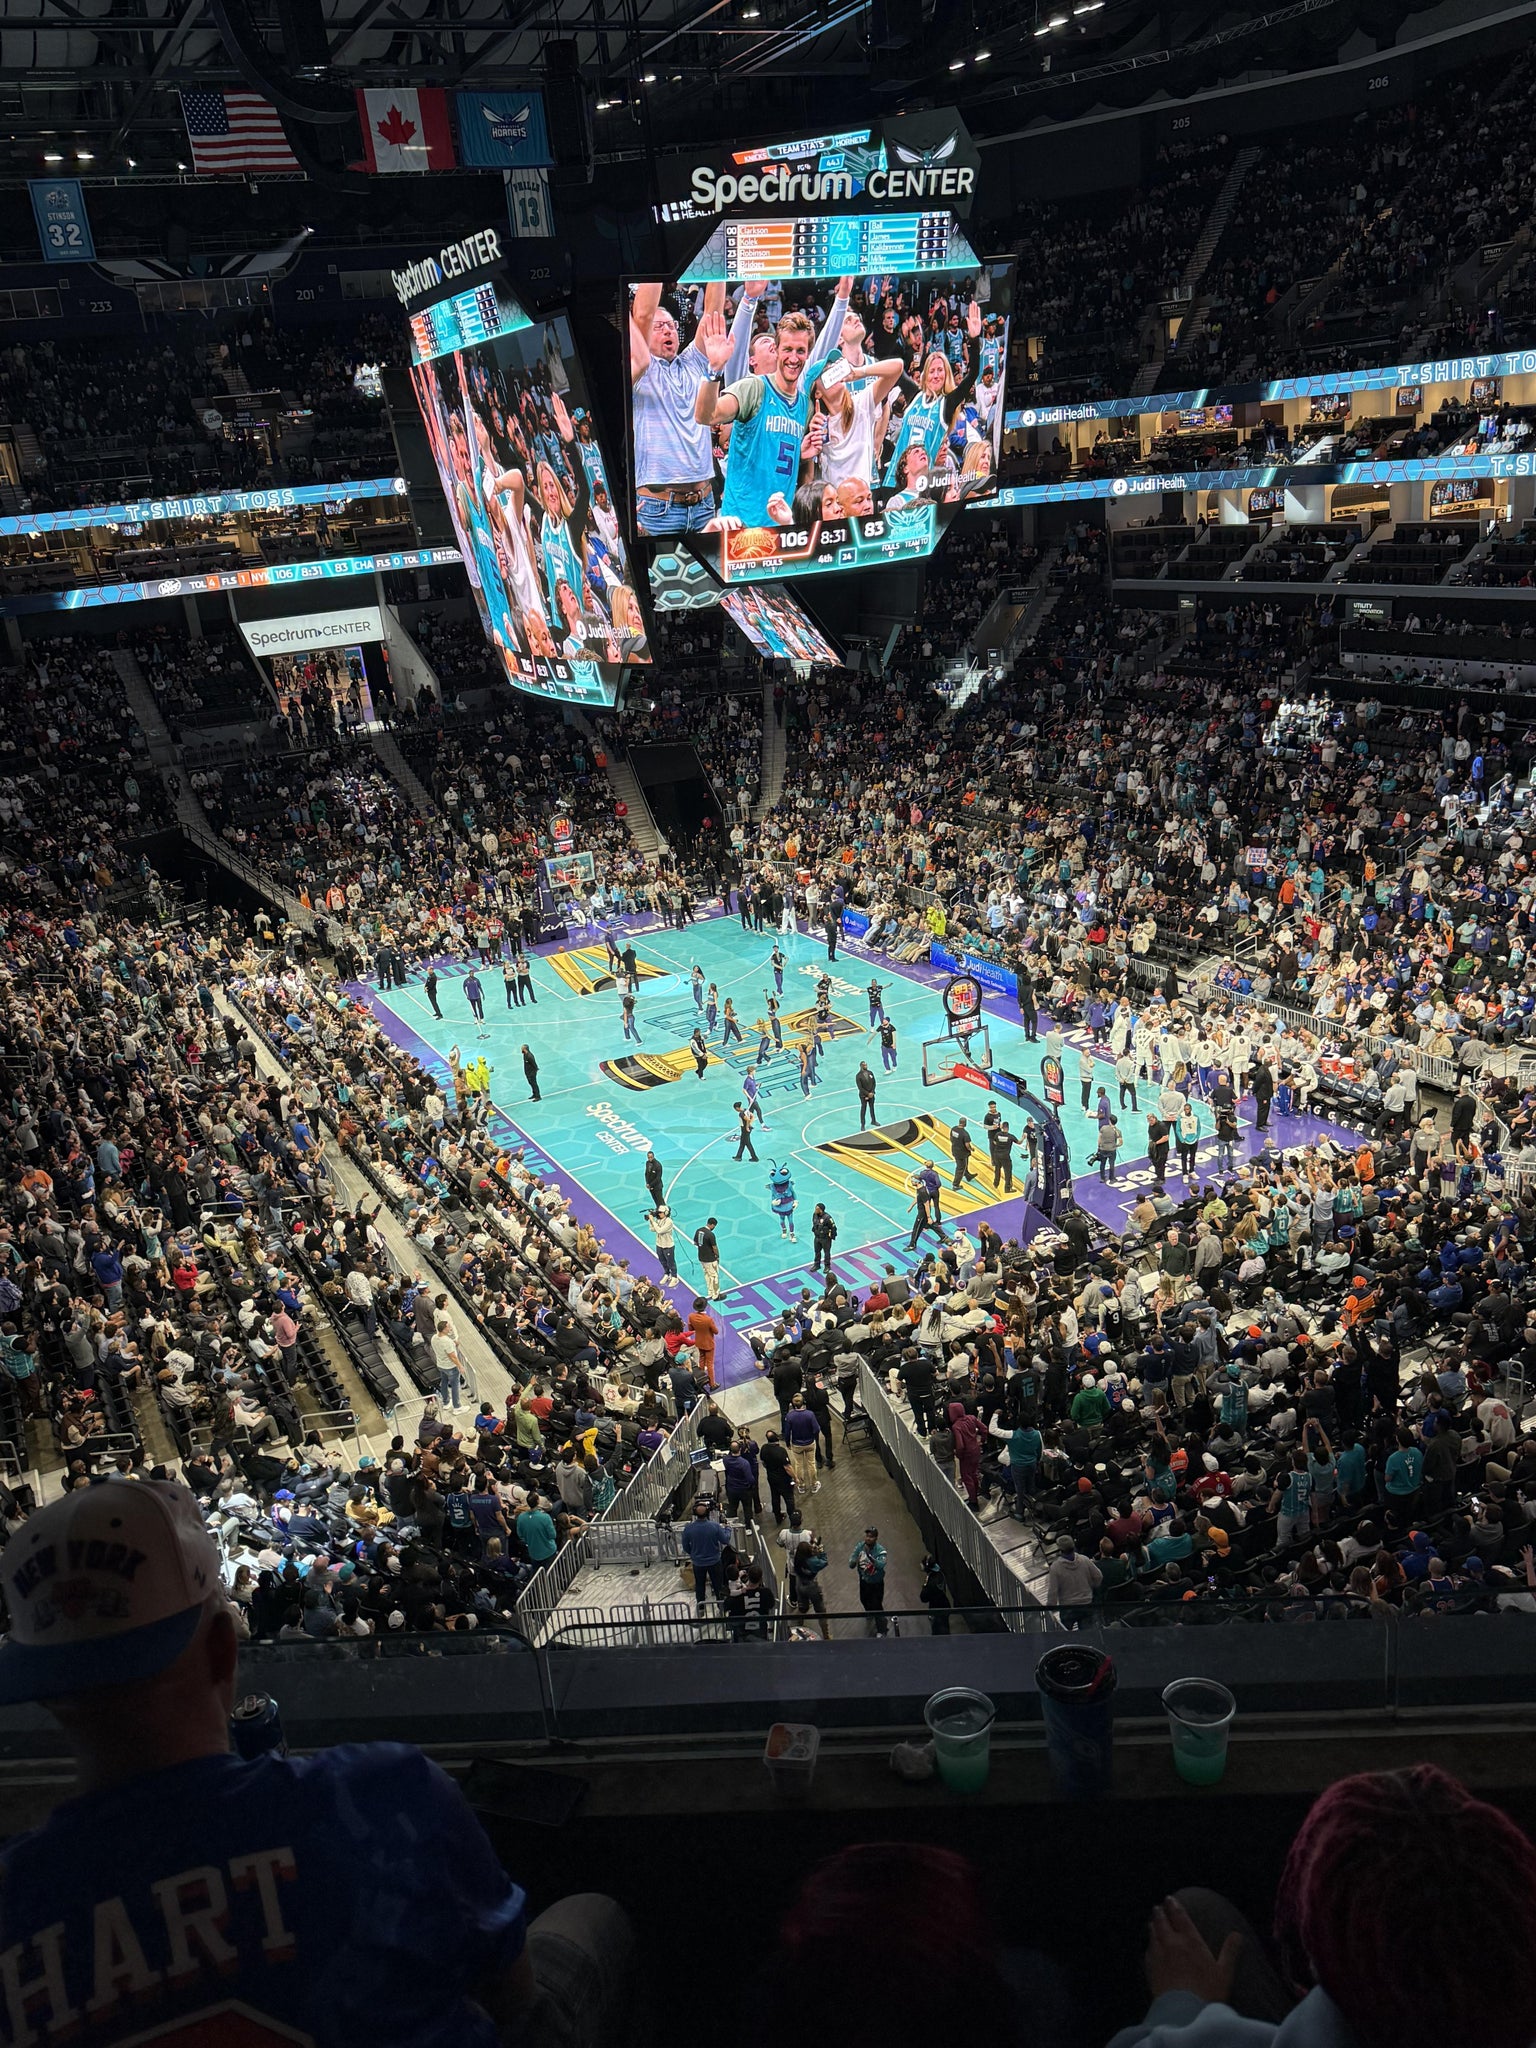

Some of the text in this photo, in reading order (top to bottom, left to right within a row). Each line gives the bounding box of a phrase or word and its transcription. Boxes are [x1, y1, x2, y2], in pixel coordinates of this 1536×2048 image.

[1367, 75, 1391, 90] 206
[1171, 116, 1191, 130] 205
[492, 127, 528, 138] HORNETS
[777, 144, 800, 155] TEAM
[799, 140, 825, 152] STATS
[836, 136, 866, 147] HORNETS
[744, 152, 767, 162] KNICKS
[691, 167, 975, 213] Spectrum CENTER
[519, 197, 540, 227] 13
[726, 226, 738, 235] 00
[740, 227, 769, 235] Clarkson
[871, 221, 883, 230] Ball
[47, 223, 84, 247] 32
[740, 238, 759, 246] Kolek
[740, 249, 771, 258] Robinson
[871, 254, 887, 263] Miller
[740, 260, 765, 269] Bridges
[831, 254, 857, 269] QTR
[391, 228, 502, 311] Spectrum CENTER
[530, 267, 551, 280] 202
[296, 289, 316, 301] 201
[90, 301, 113, 312] 233
[1398, 357, 1491, 386] T-SHIRT
[907, 415, 935, 432] HORNETS
[775, 441, 795, 477] 5
[126, 489, 296, 521] T-SHIRT TOSS
[864, 521, 884, 537] 83
[780, 530, 809, 547] 106
[820, 528, 846, 545] 8:31
[905, 539, 920, 548] TEAM
[882, 542, 900, 552] FOULS
[763, 559, 784, 567] FOULS
[818, 553, 833, 563] 4th
[189, 580, 207, 590] TOL
[221, 576, 238, 586] FLS
[251, 571, 270, 583] NYK
[274, 569, 294, 580] 106
[301, 566, 324, 578] 8:31
[334, 562, 349, 573] 83
[354, 560, 374, 570] CHA
[376, 558, 391, 568] FLS
[403, 555, 419, 564] TOL
[729, 562, 746, 571] TEAM
[250, 621, 372, 648] Spectrum CENTER
[555, 825, 570, 839] 24
[585, 1101, 654, 1152] Spectrum
[595, 1130, 630, 1156] CENTER
[1112, 1312, 1120, 1324] 9
[1022, 1376, 1035, 1397] 16
[1297, 1489, 1307, 1501] 2
[453, 1508, 465, 1520] 2
[13, 1539, 148, 1599] NEW YORK
[0, 1844, 299, 2044] HART
